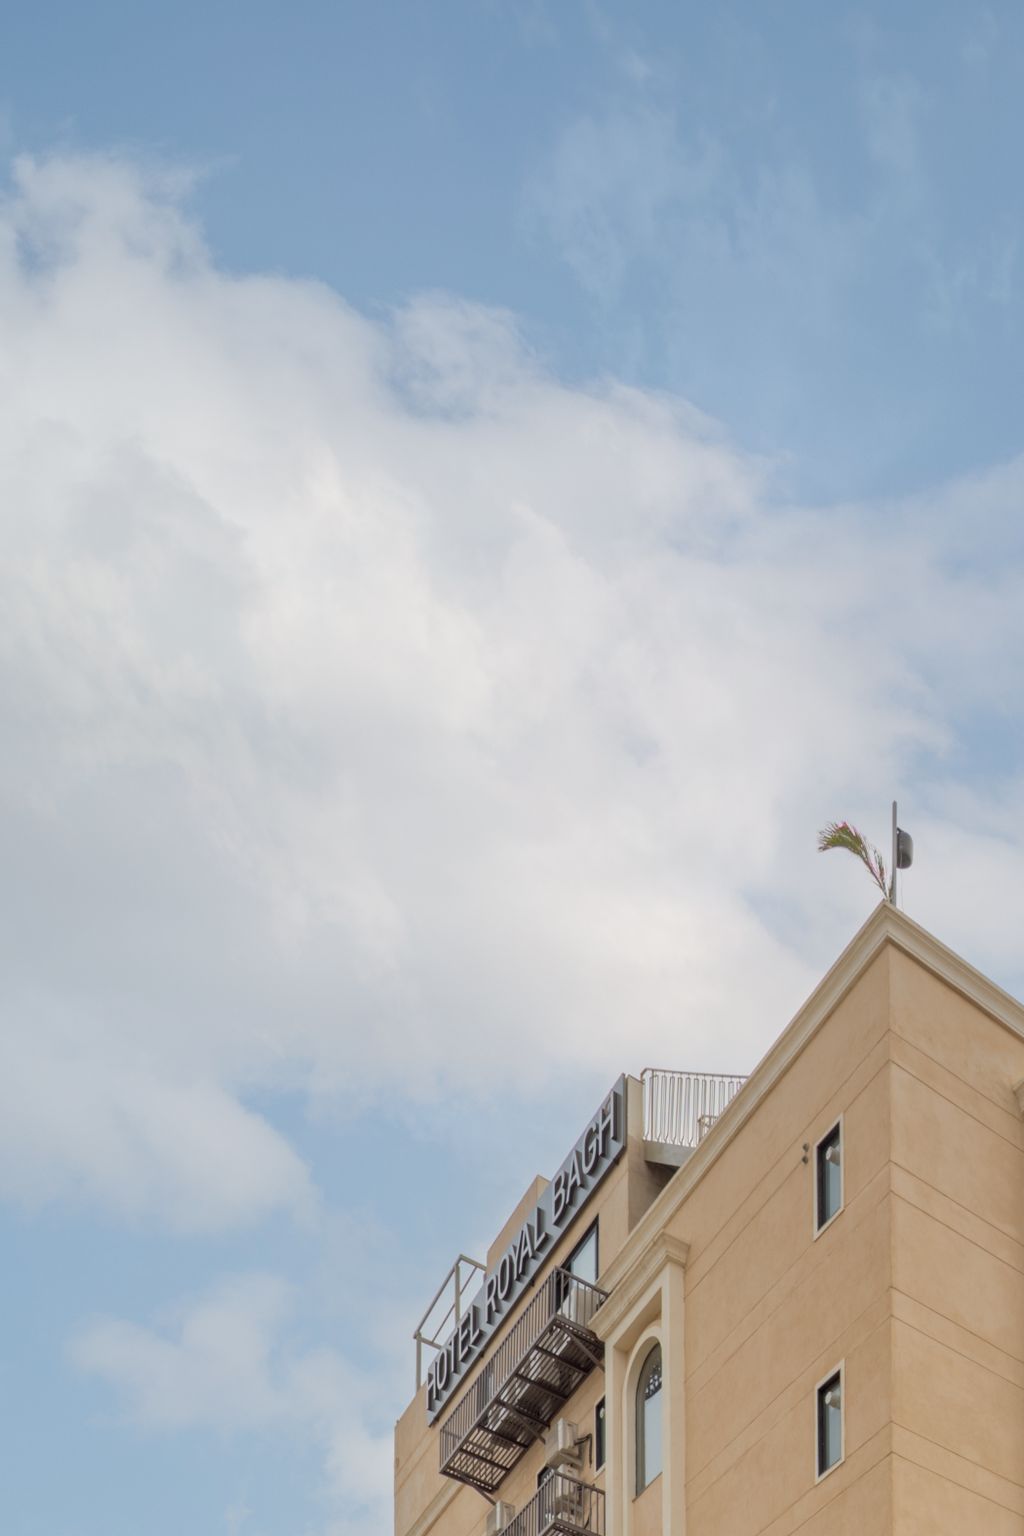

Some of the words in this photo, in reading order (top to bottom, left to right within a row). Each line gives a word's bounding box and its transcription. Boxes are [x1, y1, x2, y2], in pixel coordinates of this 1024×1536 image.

[427, 1305, 481, 1411] HOTEL
[485, 1207, 548, 1322] ROYAL
[553, 1091, 618, 1226] BAGH
